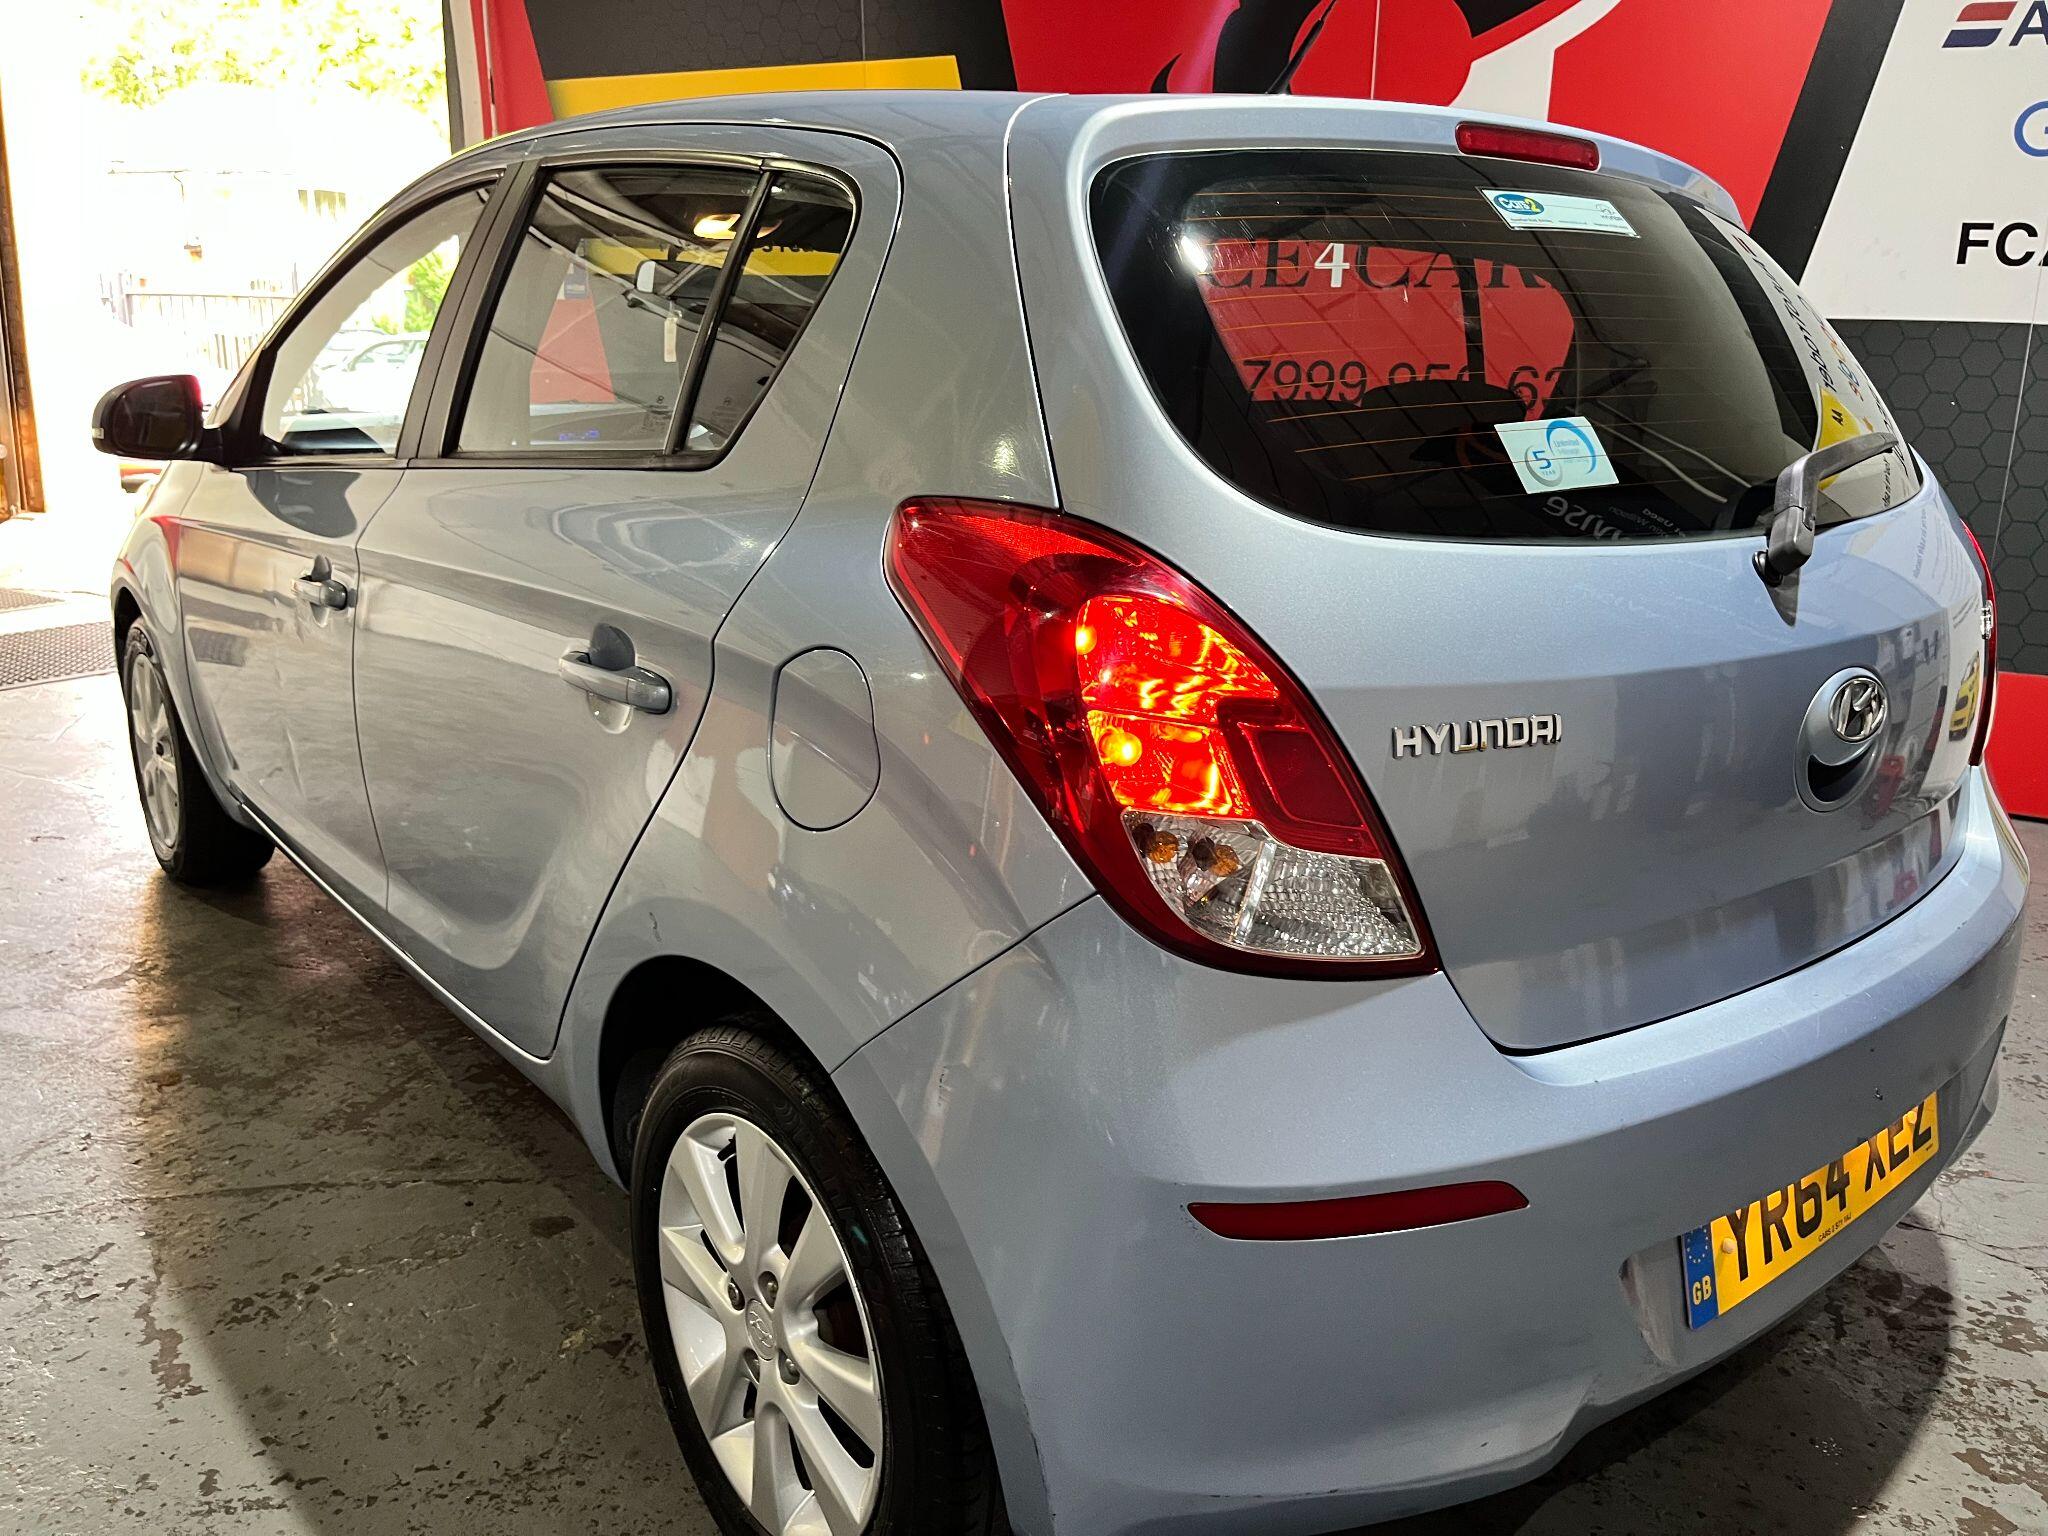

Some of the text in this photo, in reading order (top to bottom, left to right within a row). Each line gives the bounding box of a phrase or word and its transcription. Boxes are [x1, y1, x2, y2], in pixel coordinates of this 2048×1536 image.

[1956, 222, 2048, 267] FC
[1532, 450, 1552, 470] 5
[1393, 713, 1562, 759] HYUNDAI
[1692, 1275, 1712, 1306] GB
